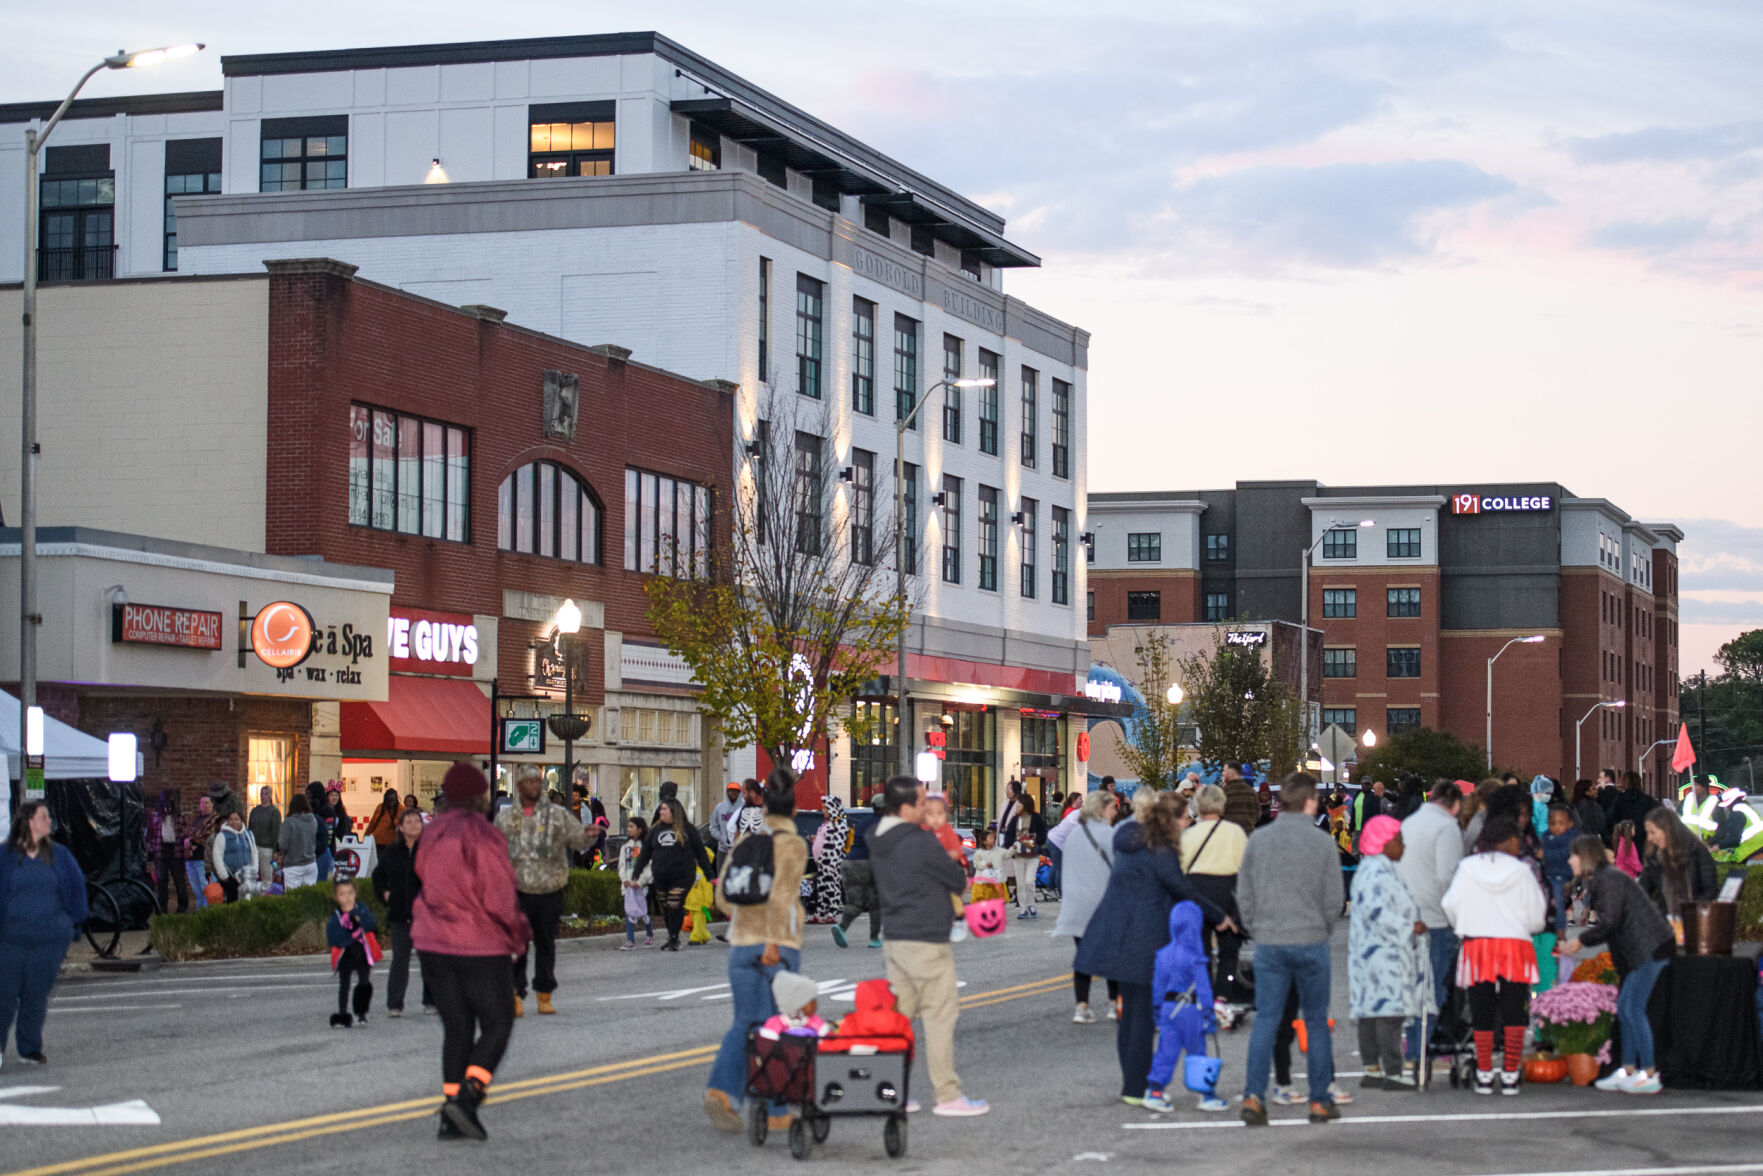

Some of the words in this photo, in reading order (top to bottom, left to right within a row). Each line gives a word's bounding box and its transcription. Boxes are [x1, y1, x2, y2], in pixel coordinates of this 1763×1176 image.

[856, 250, 919, 292] GODBOLD
[944, 288, 1001, 330] BUILDING
[1454, 494, 1478, 514] 191
[1482, 497, 1550, 510] COLLEGE
[125, 606, 171, 632] PHONE
[175, 612, 218, 637] REPAIR
[128, 630, 157, 641] COMPUTER
[158, 633, 176, 642] REPAIR
[179, 634, 197, 644] TABLET
[342, 623, 373, 664] Spa
[388, 617, 409, 659] VE
[415, 619, 478, 665] GUYS
[260, 648, 302, 657] CELLAIRIS
[277, 667, 294, 683] spa
[306, 666, 326, 682] wax
[336, 665, 361, 685] relax
[530, 723, 538, 735] 2
